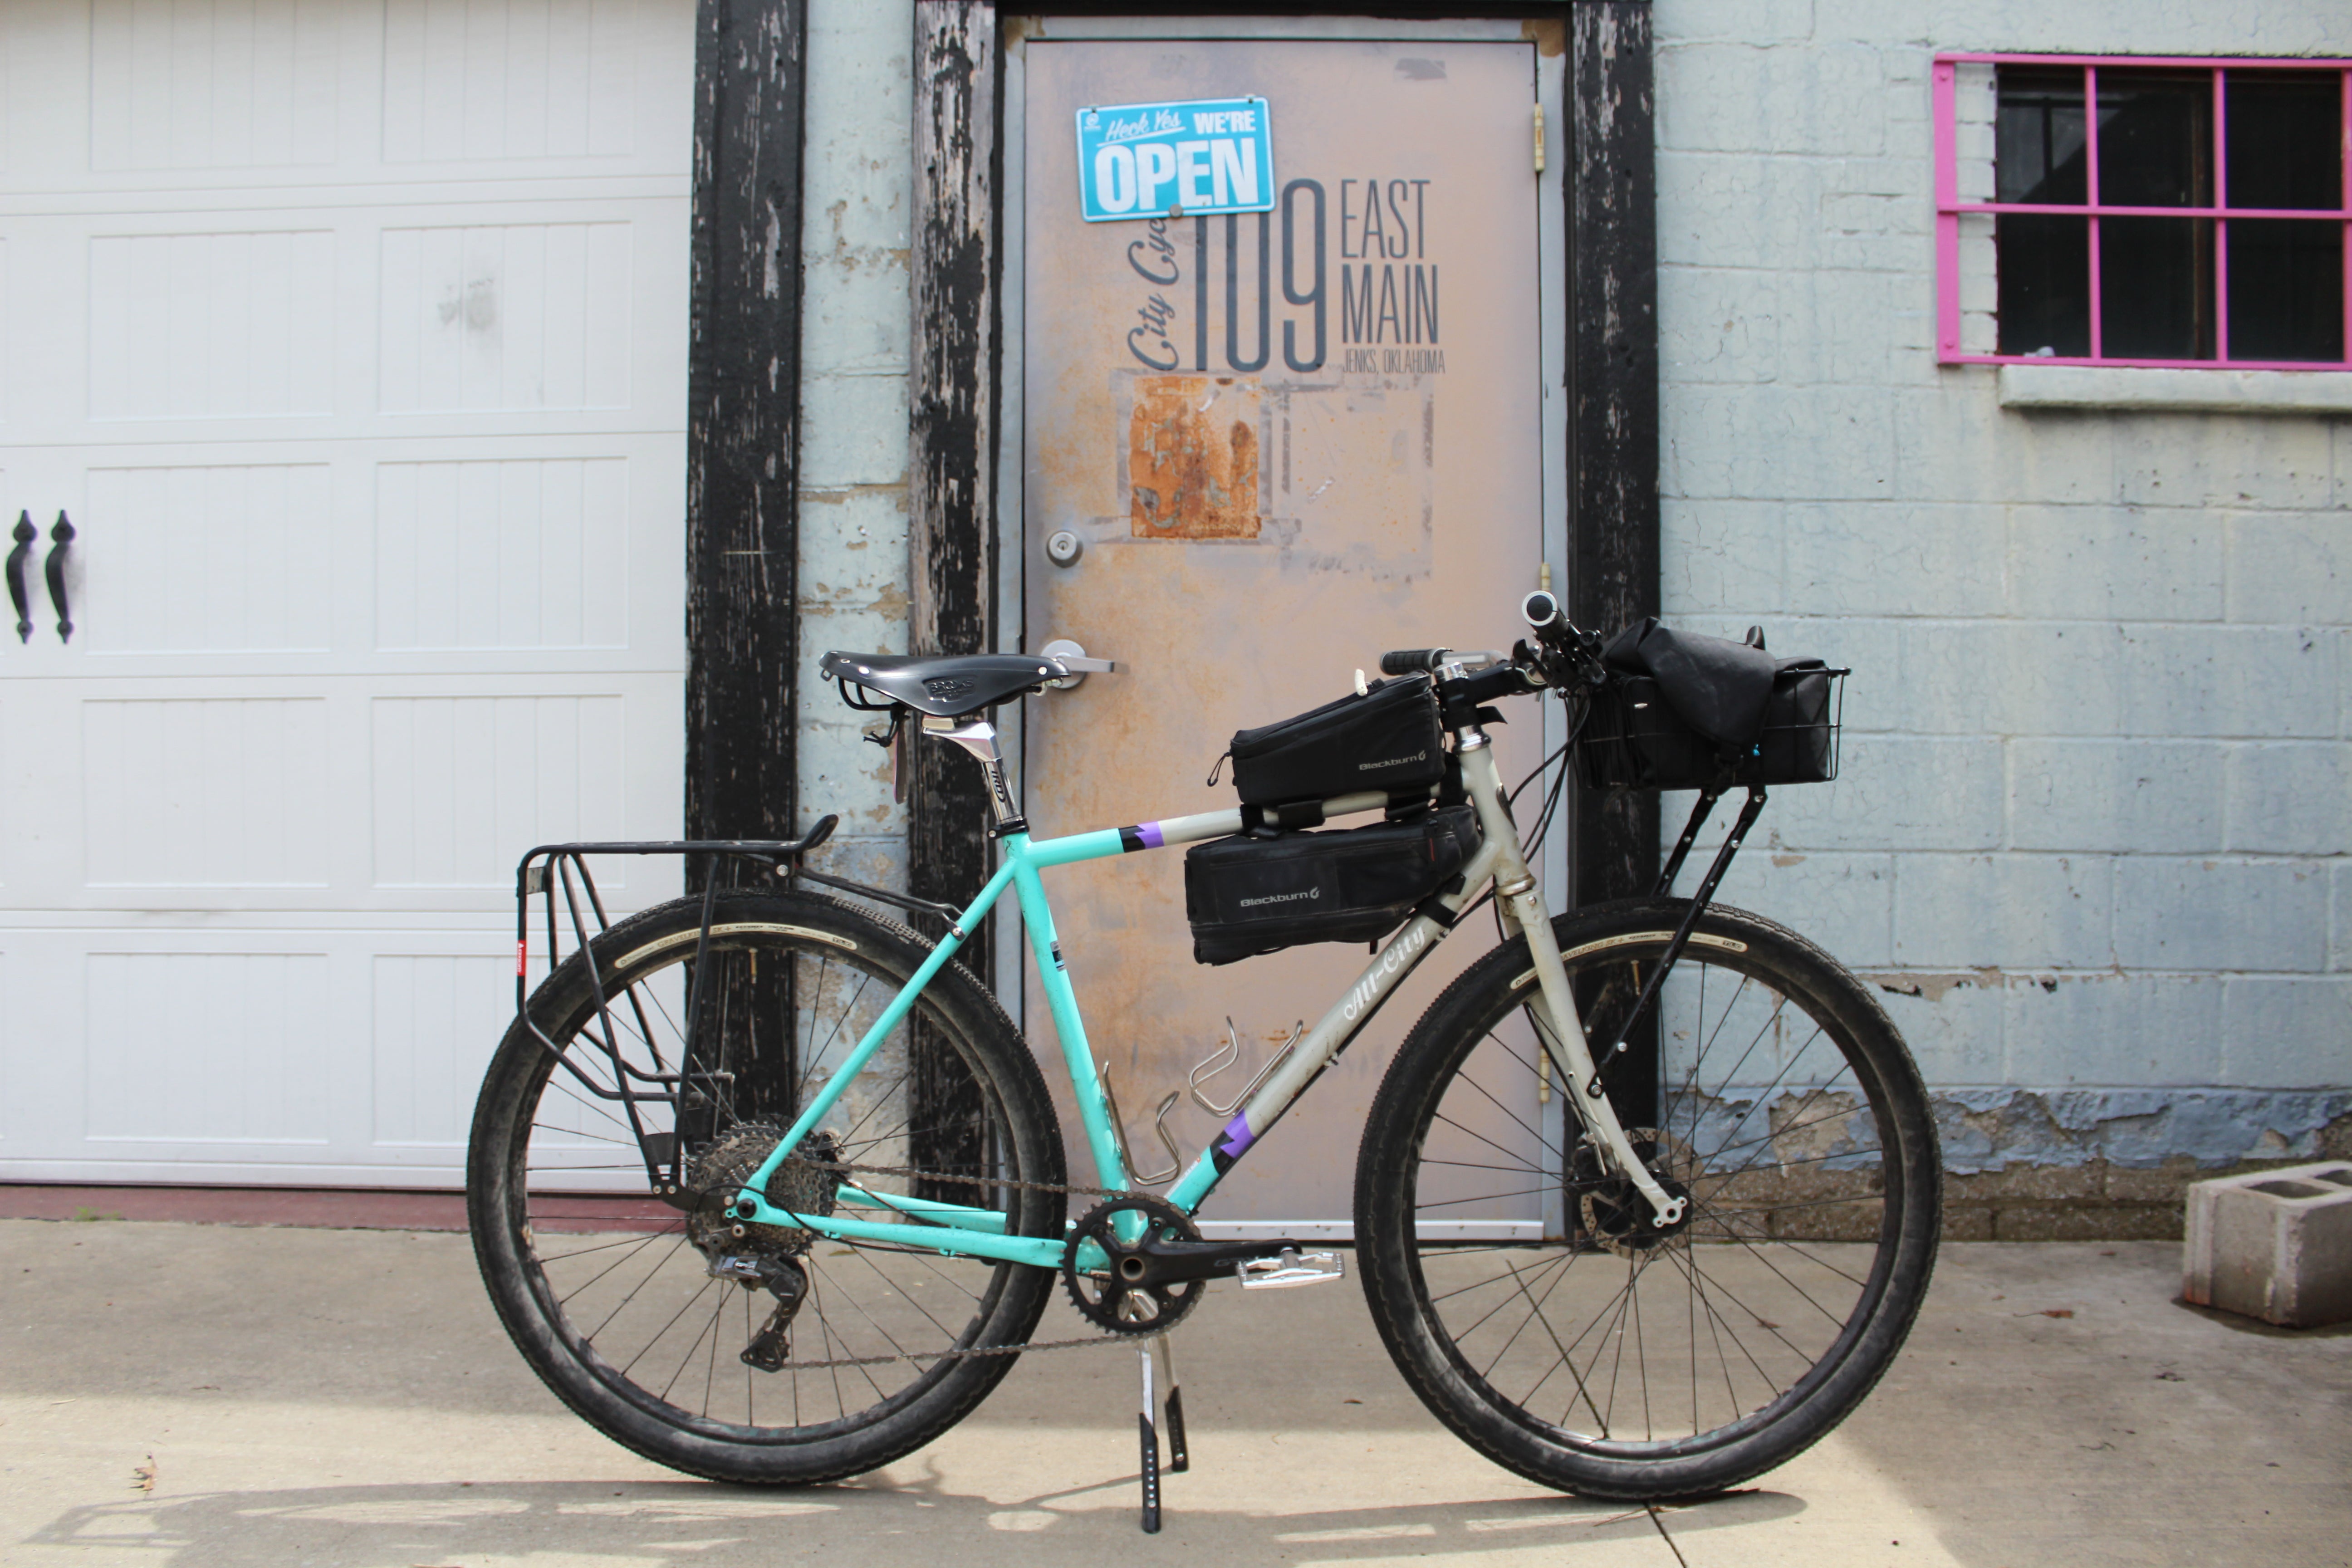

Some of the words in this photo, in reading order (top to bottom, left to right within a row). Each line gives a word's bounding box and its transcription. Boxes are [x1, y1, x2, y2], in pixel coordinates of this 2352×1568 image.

[1104, 112, 1149, 141] Heck
[1154, 108, 1182, 130] Yes
[1193, 110, 1256, 134] WE'RE
[1094, 137, 1259, 213] OPEN
[1128, 219, 1179, 285] Cyc
[1342, 180, 1431, 259] EAST
[1196, 178, 1326, 372] 109
[1342, 264, 1438, 343] MAIN
[1128, 292, 1179, 371] City
[1343, 348, 1379, 375] JENKS,
[1384, 348, 1446, 374] OKLAHOMA
[1359, 755, 1417, 770] Blackburn
[1240, 892, 1308, 907] Blackburn
[1344, 926, 1425, 1020] All-City
